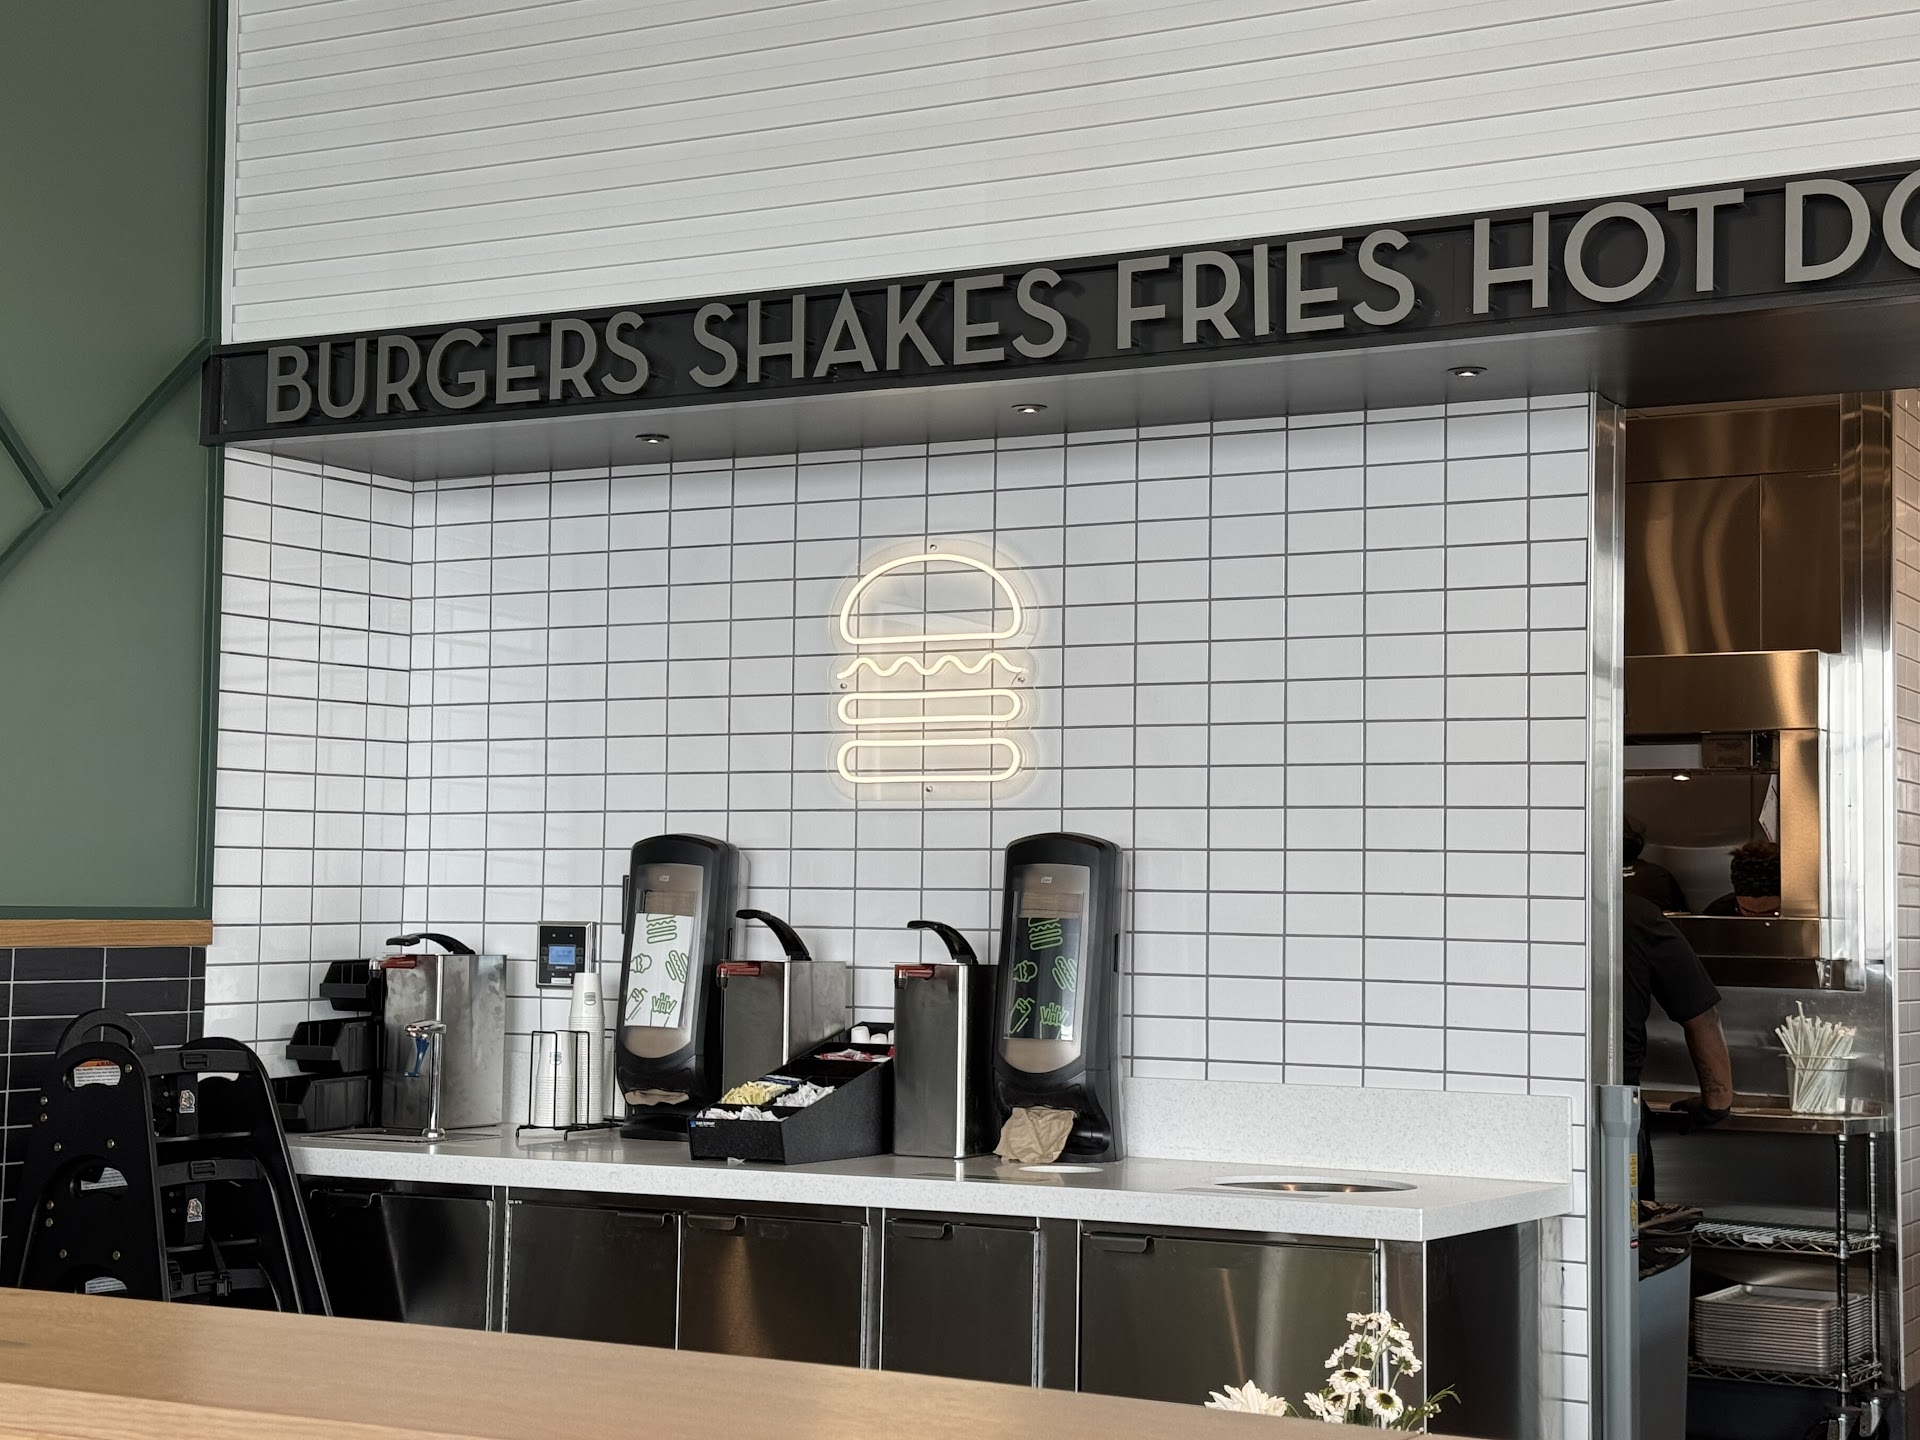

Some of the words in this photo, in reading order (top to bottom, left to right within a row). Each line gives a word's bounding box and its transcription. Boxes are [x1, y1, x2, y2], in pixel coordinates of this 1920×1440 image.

[266, 311, 650, 424] BURGERS
[689, 268, 1068, 388] SHAKES
[1117, 229, 1416, 349] FRIES
[1473, 188, 1744, 314] HOT
